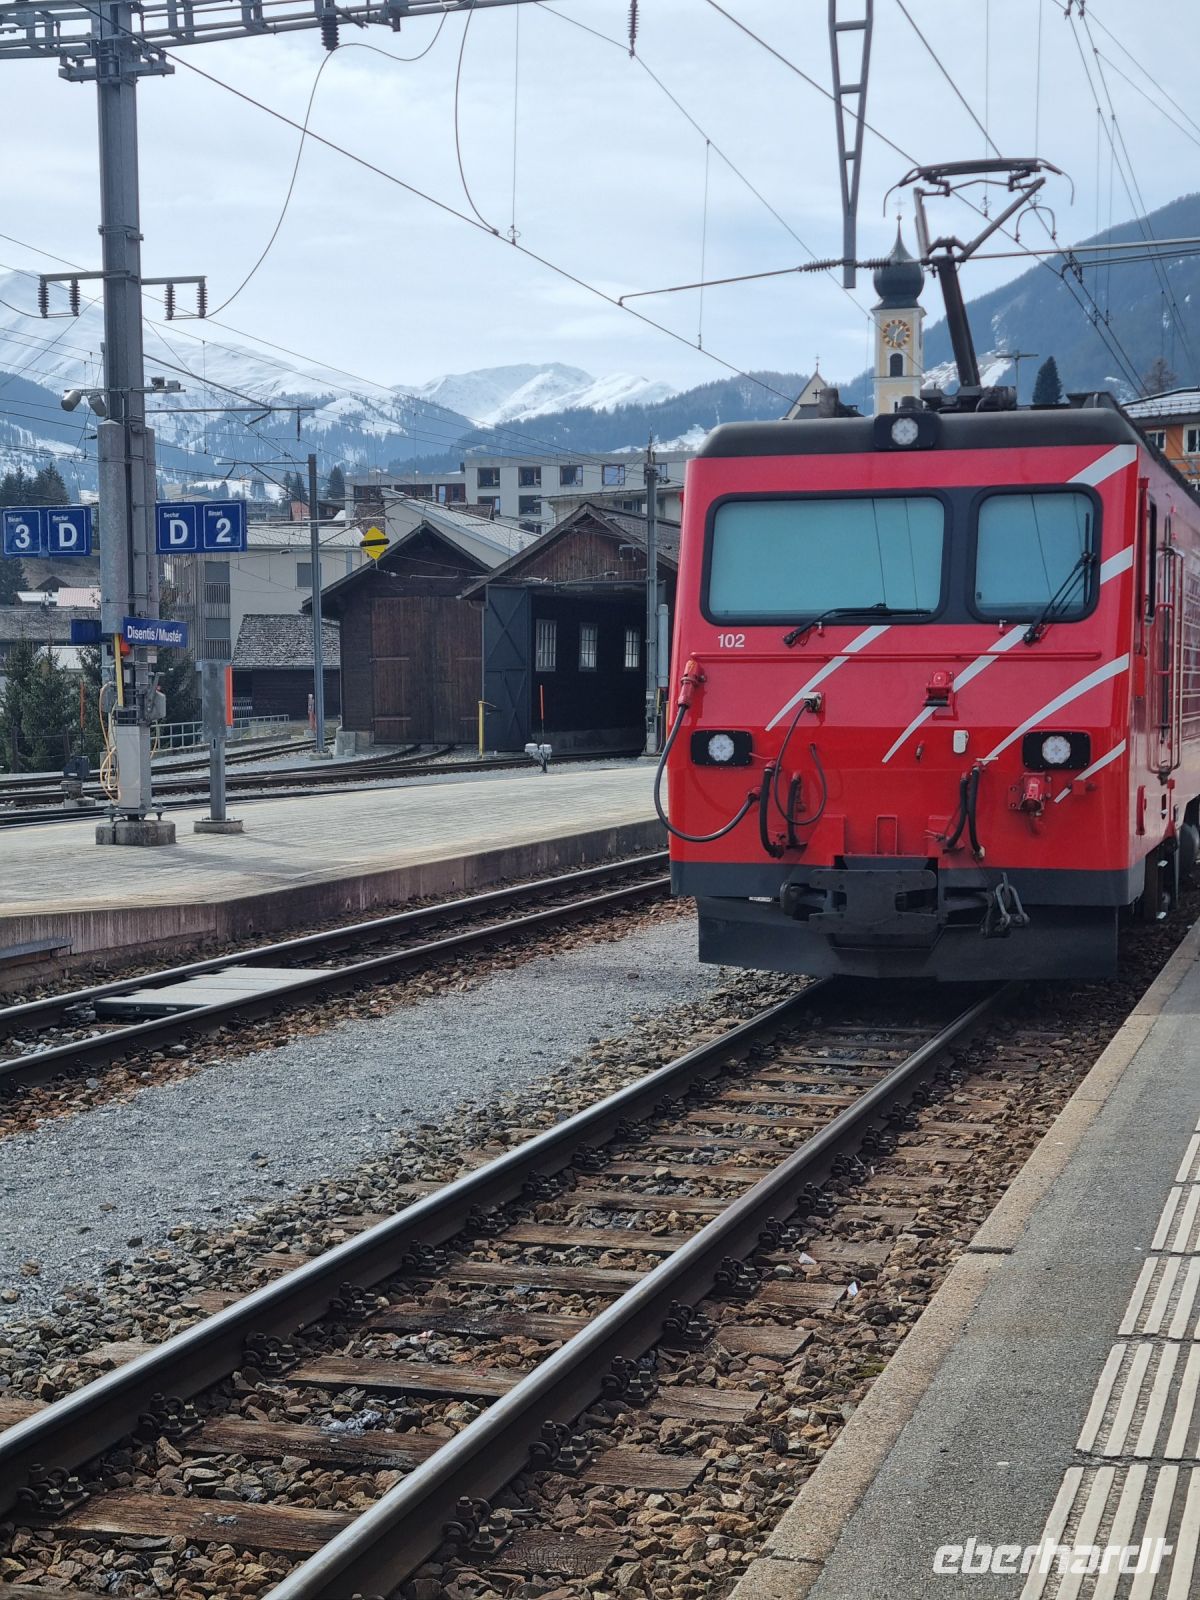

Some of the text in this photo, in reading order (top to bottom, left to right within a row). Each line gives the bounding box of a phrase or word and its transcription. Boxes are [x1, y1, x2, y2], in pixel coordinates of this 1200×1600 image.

[15, 524, 30, 548] 3
[59, 522, 77, 547] D
[169, 519, 188, 545] D
[216, 518, 231, 542] 2
[717, 633, 746, 648] 102
